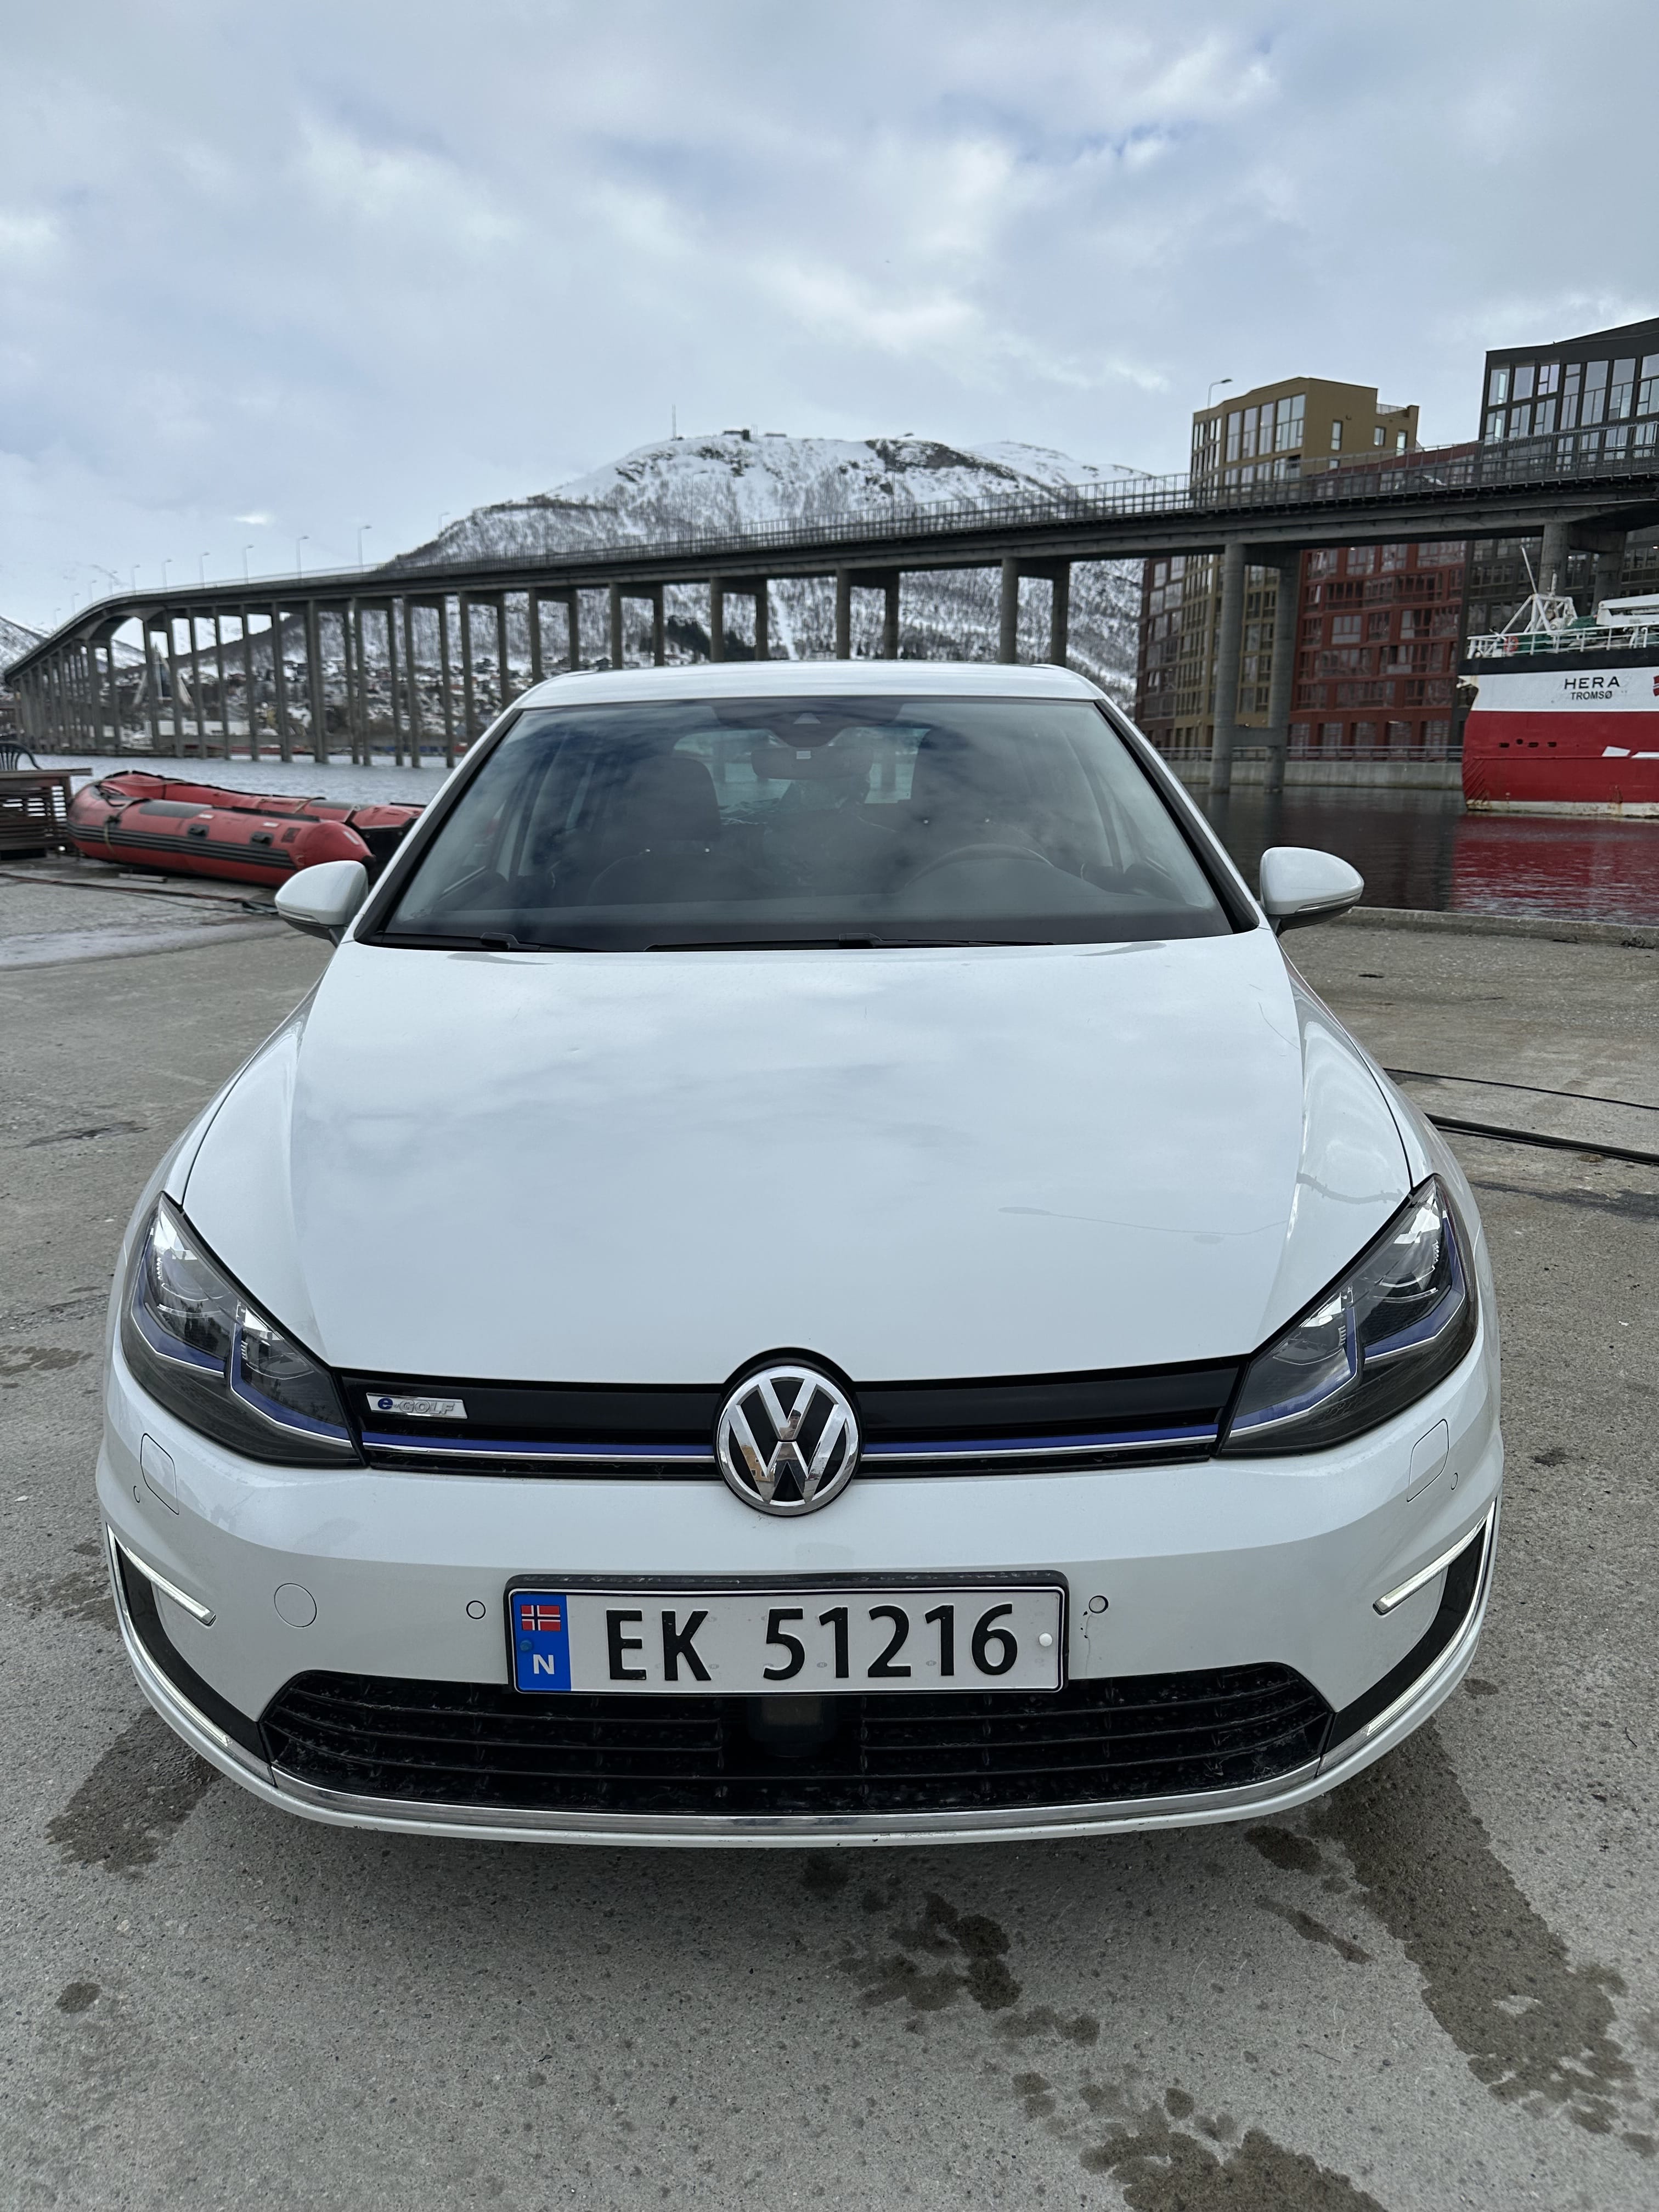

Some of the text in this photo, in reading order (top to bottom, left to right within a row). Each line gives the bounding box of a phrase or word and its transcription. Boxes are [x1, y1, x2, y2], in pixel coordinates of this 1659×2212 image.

[1564, 676, 1620, 690] HERA
[1571, 691, 1612, 700] TROMSØ
[722, 1367, 853, 1511] VW
[606, 1604, 1018, 1680] EK 51216
[533, 1654, 555, 1674] N
